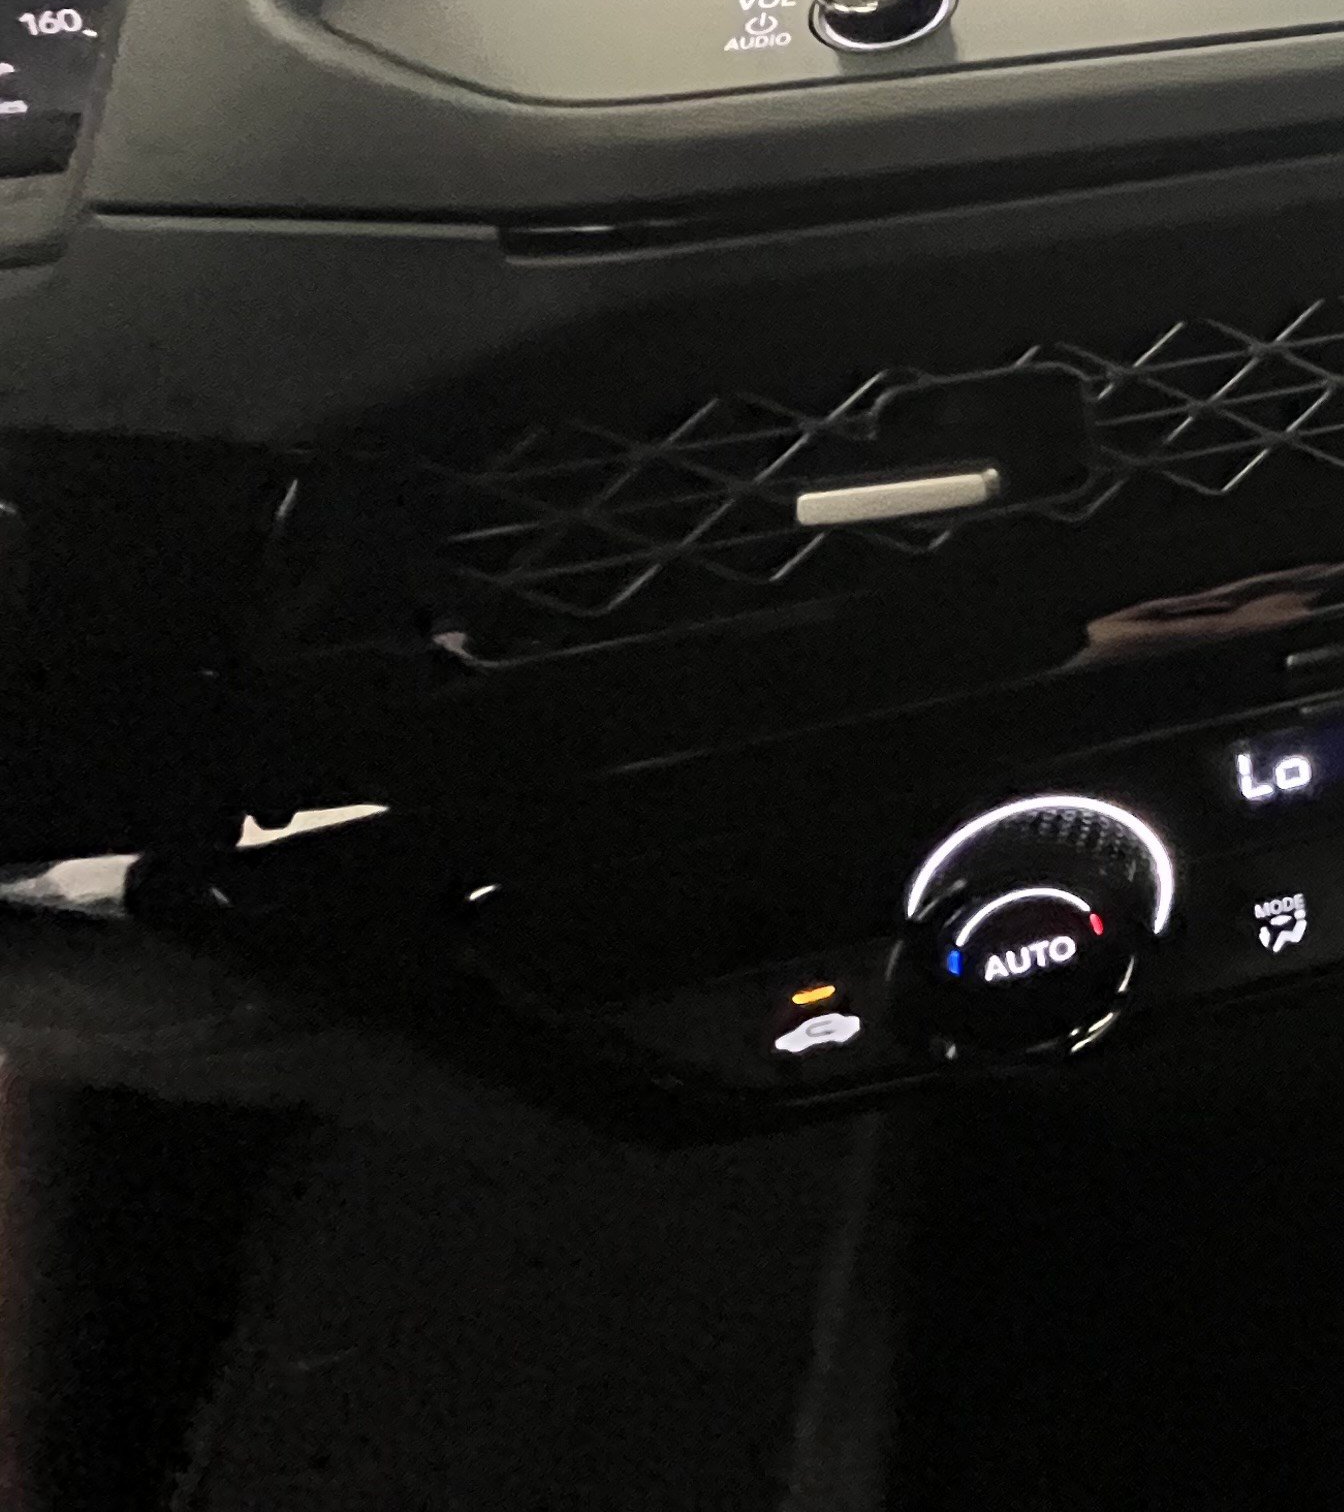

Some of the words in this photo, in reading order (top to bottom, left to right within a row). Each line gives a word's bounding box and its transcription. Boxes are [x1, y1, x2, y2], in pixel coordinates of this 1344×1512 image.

[18, 8, 83, 36] 160
[723, 31, 792, 52] AUDIO
[1236, 753, 1312, 801] Lo
[1253, 893, 1306, 919] MODE
[984, 935, 1077, 982] AUTO
